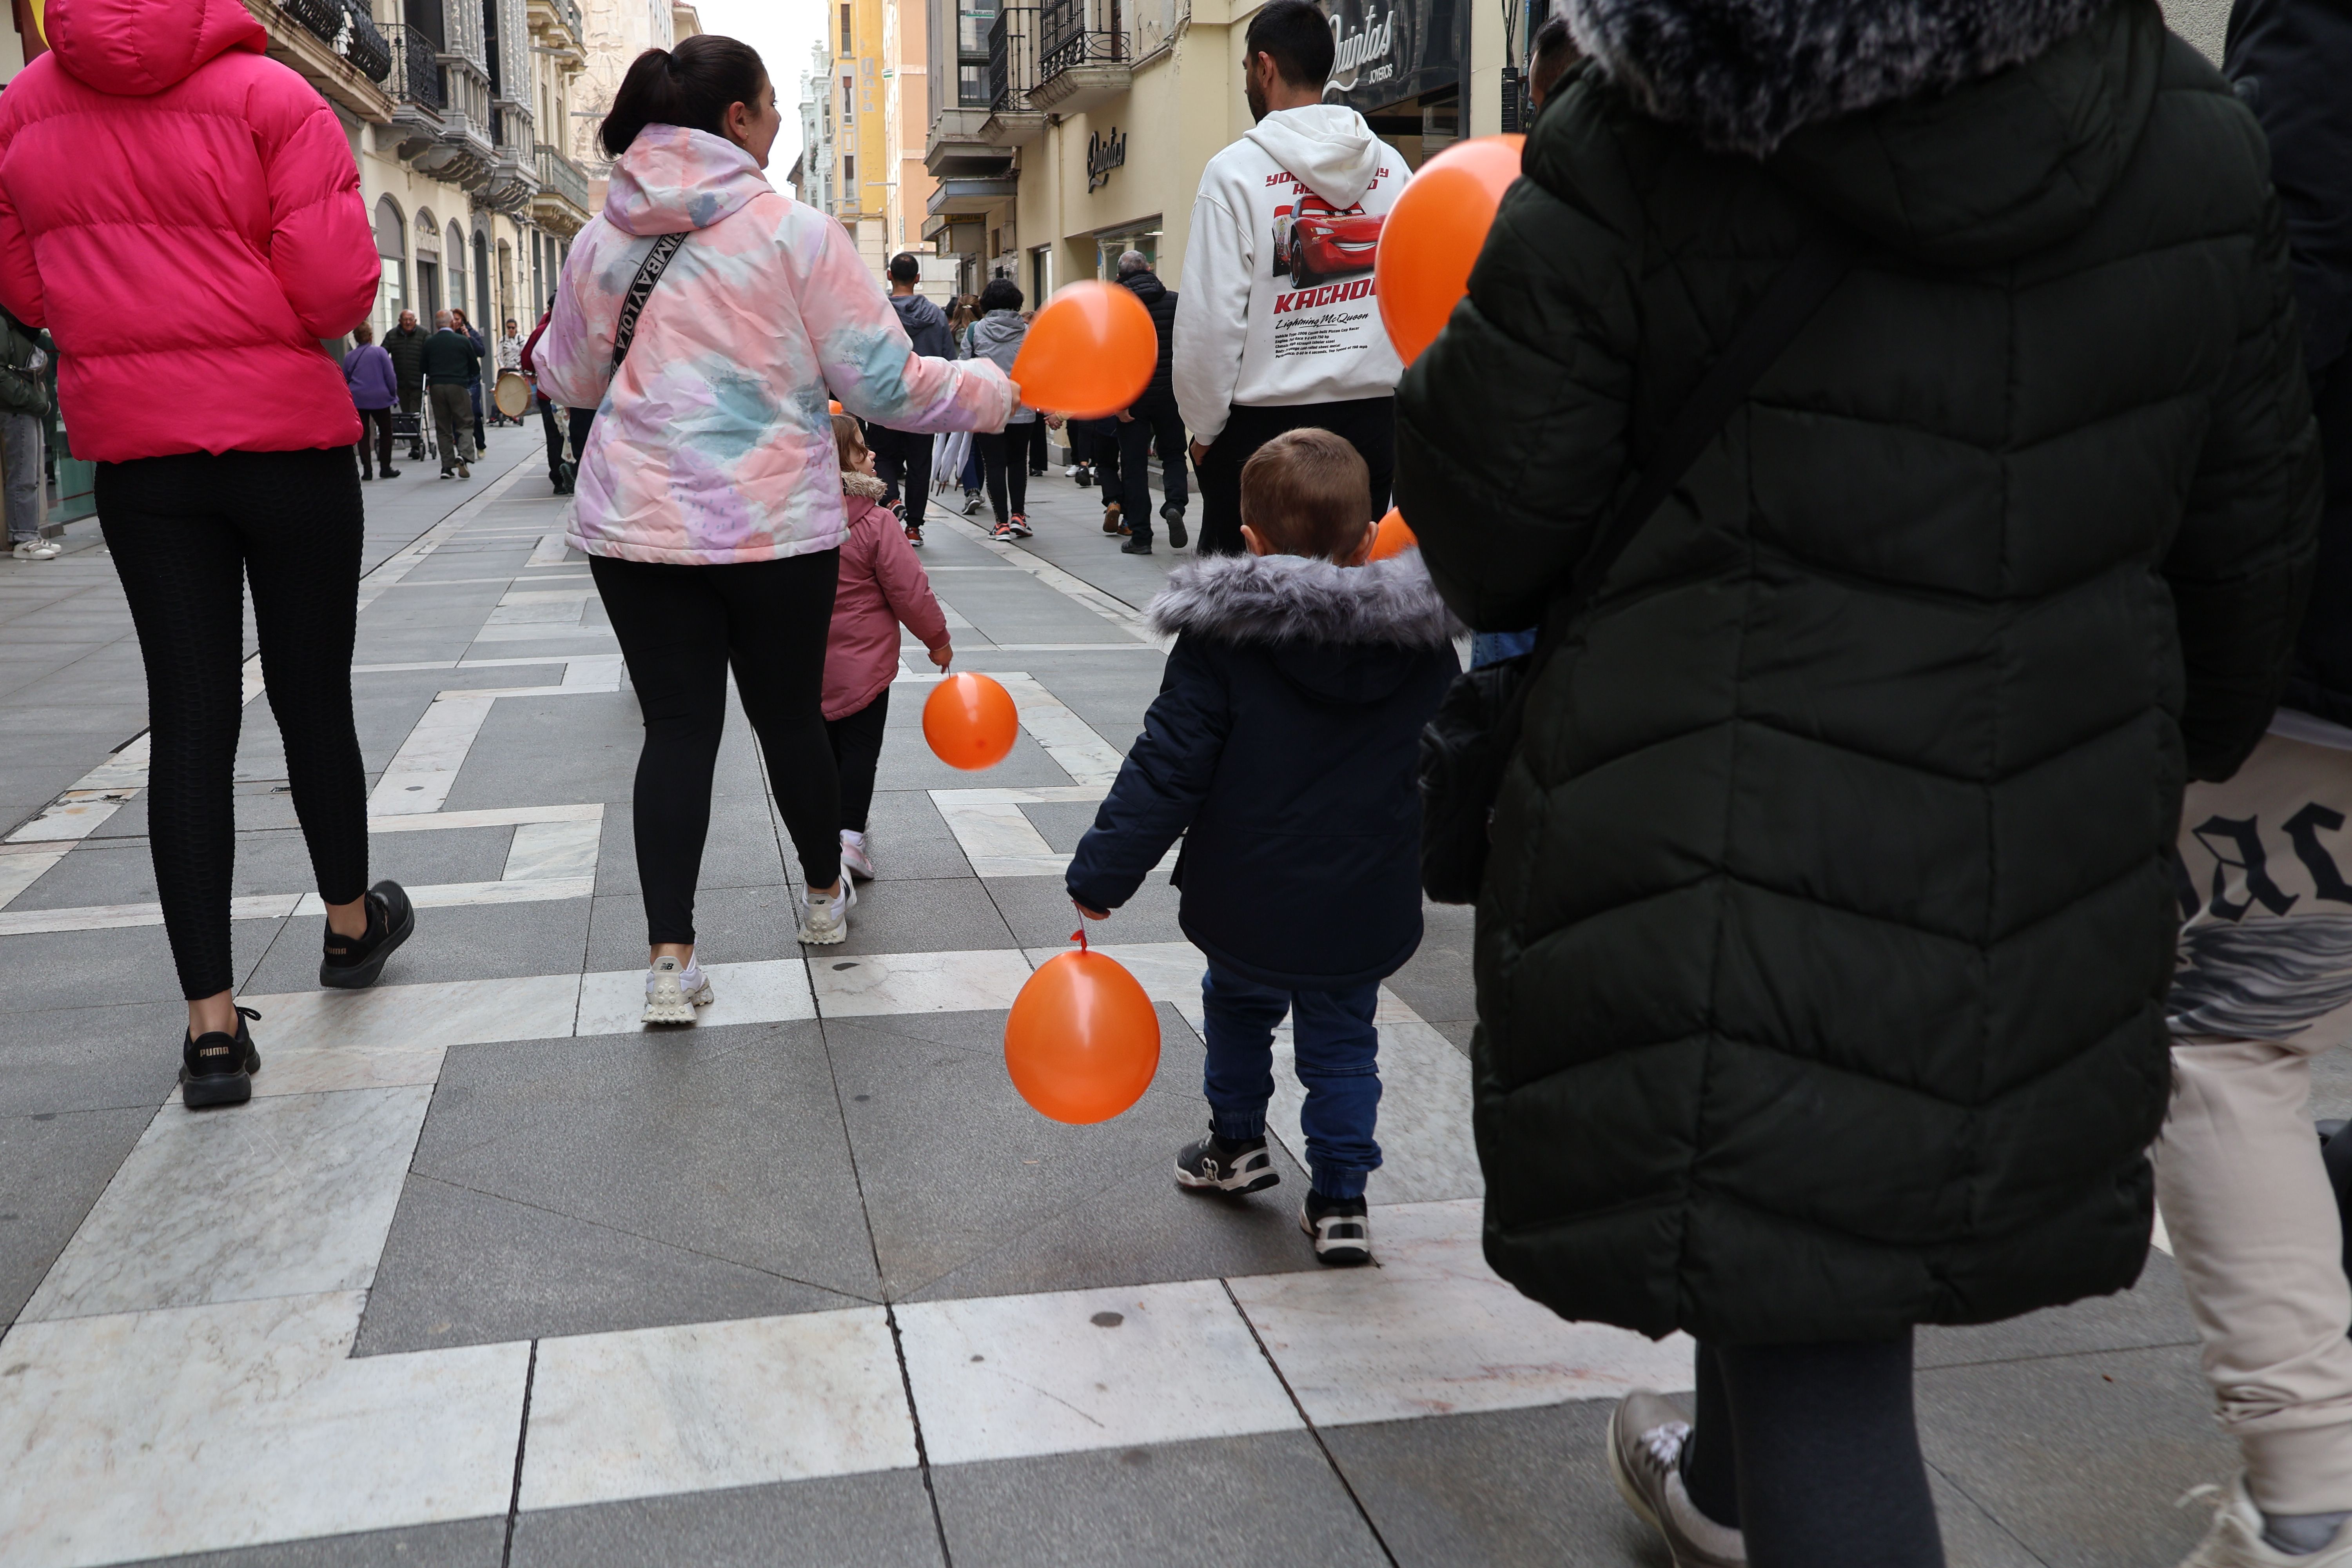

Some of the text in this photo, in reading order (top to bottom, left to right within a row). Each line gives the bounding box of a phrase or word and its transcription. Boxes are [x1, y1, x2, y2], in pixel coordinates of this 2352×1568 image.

[1369, 63, 1392, 84] JOYEROS
[1087, 127, 1127, 194] Quintas
[1275, 312, 1369, 330] Lightning McQueen
[200, 1046, 229, 1057] PUMA
